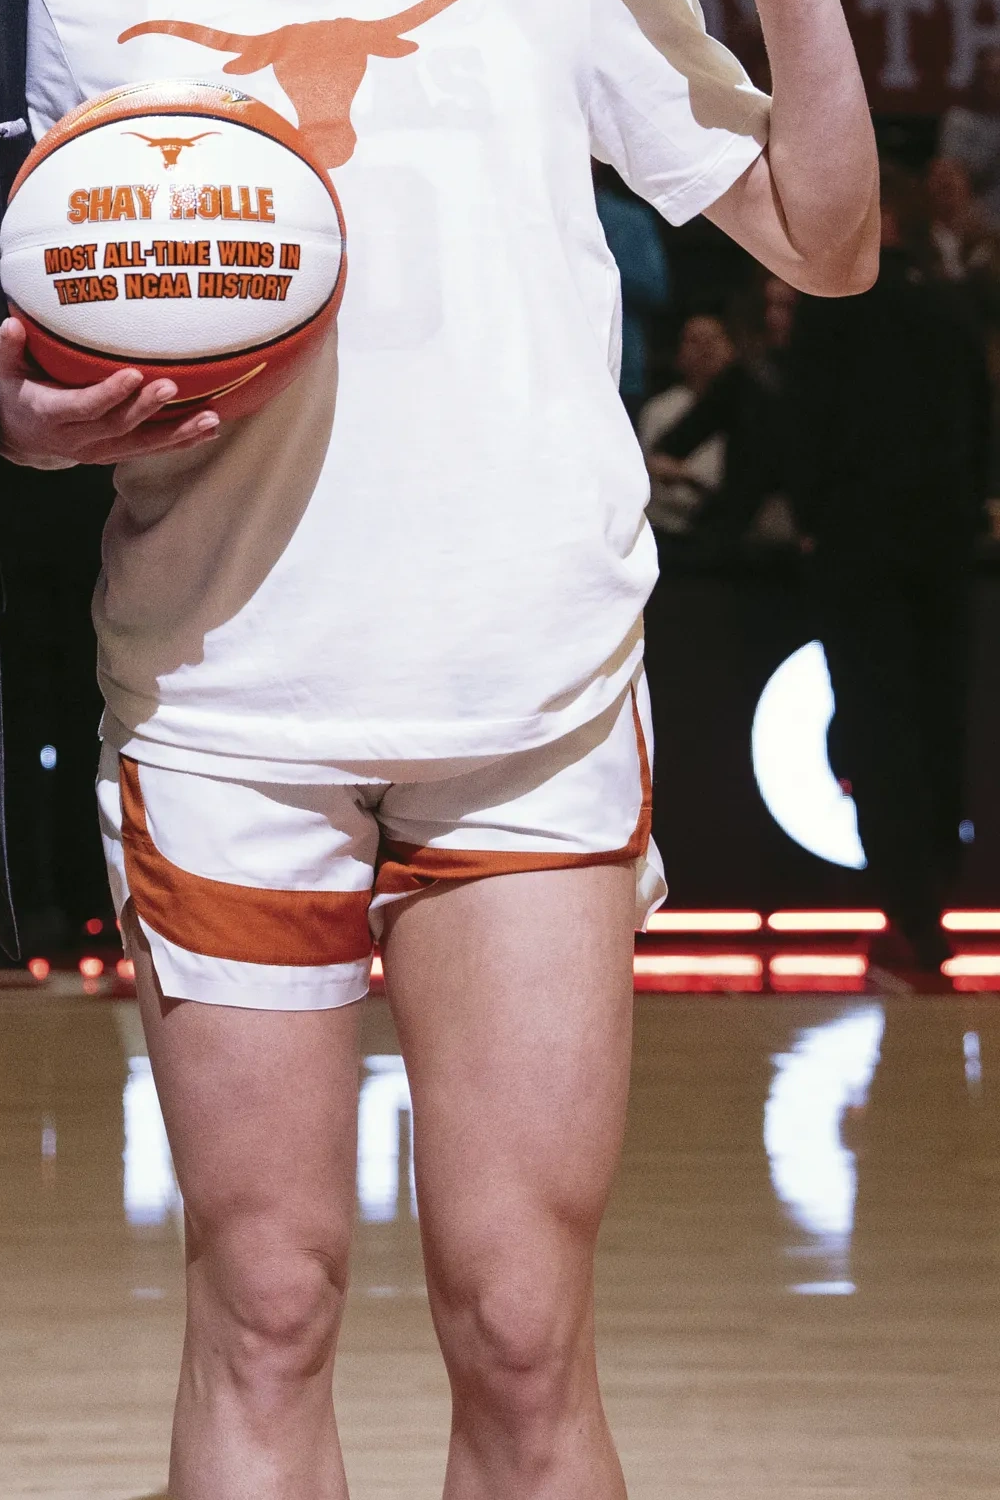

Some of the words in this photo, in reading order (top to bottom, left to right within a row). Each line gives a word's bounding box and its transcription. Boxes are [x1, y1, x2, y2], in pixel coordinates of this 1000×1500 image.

[67, 184, 159, 224] SHAY
[44, 243, 98, 275] MOST
[103, 240, 211, 268] ALL-TIME
[217, 240, 275, 268] WINS
[279, 243, 301, 270] IN
[53, 275, 119, 305] TEXAS
[124, 272, 192, 300] NCAA
[198, 272, 293, 301] HISTORY
